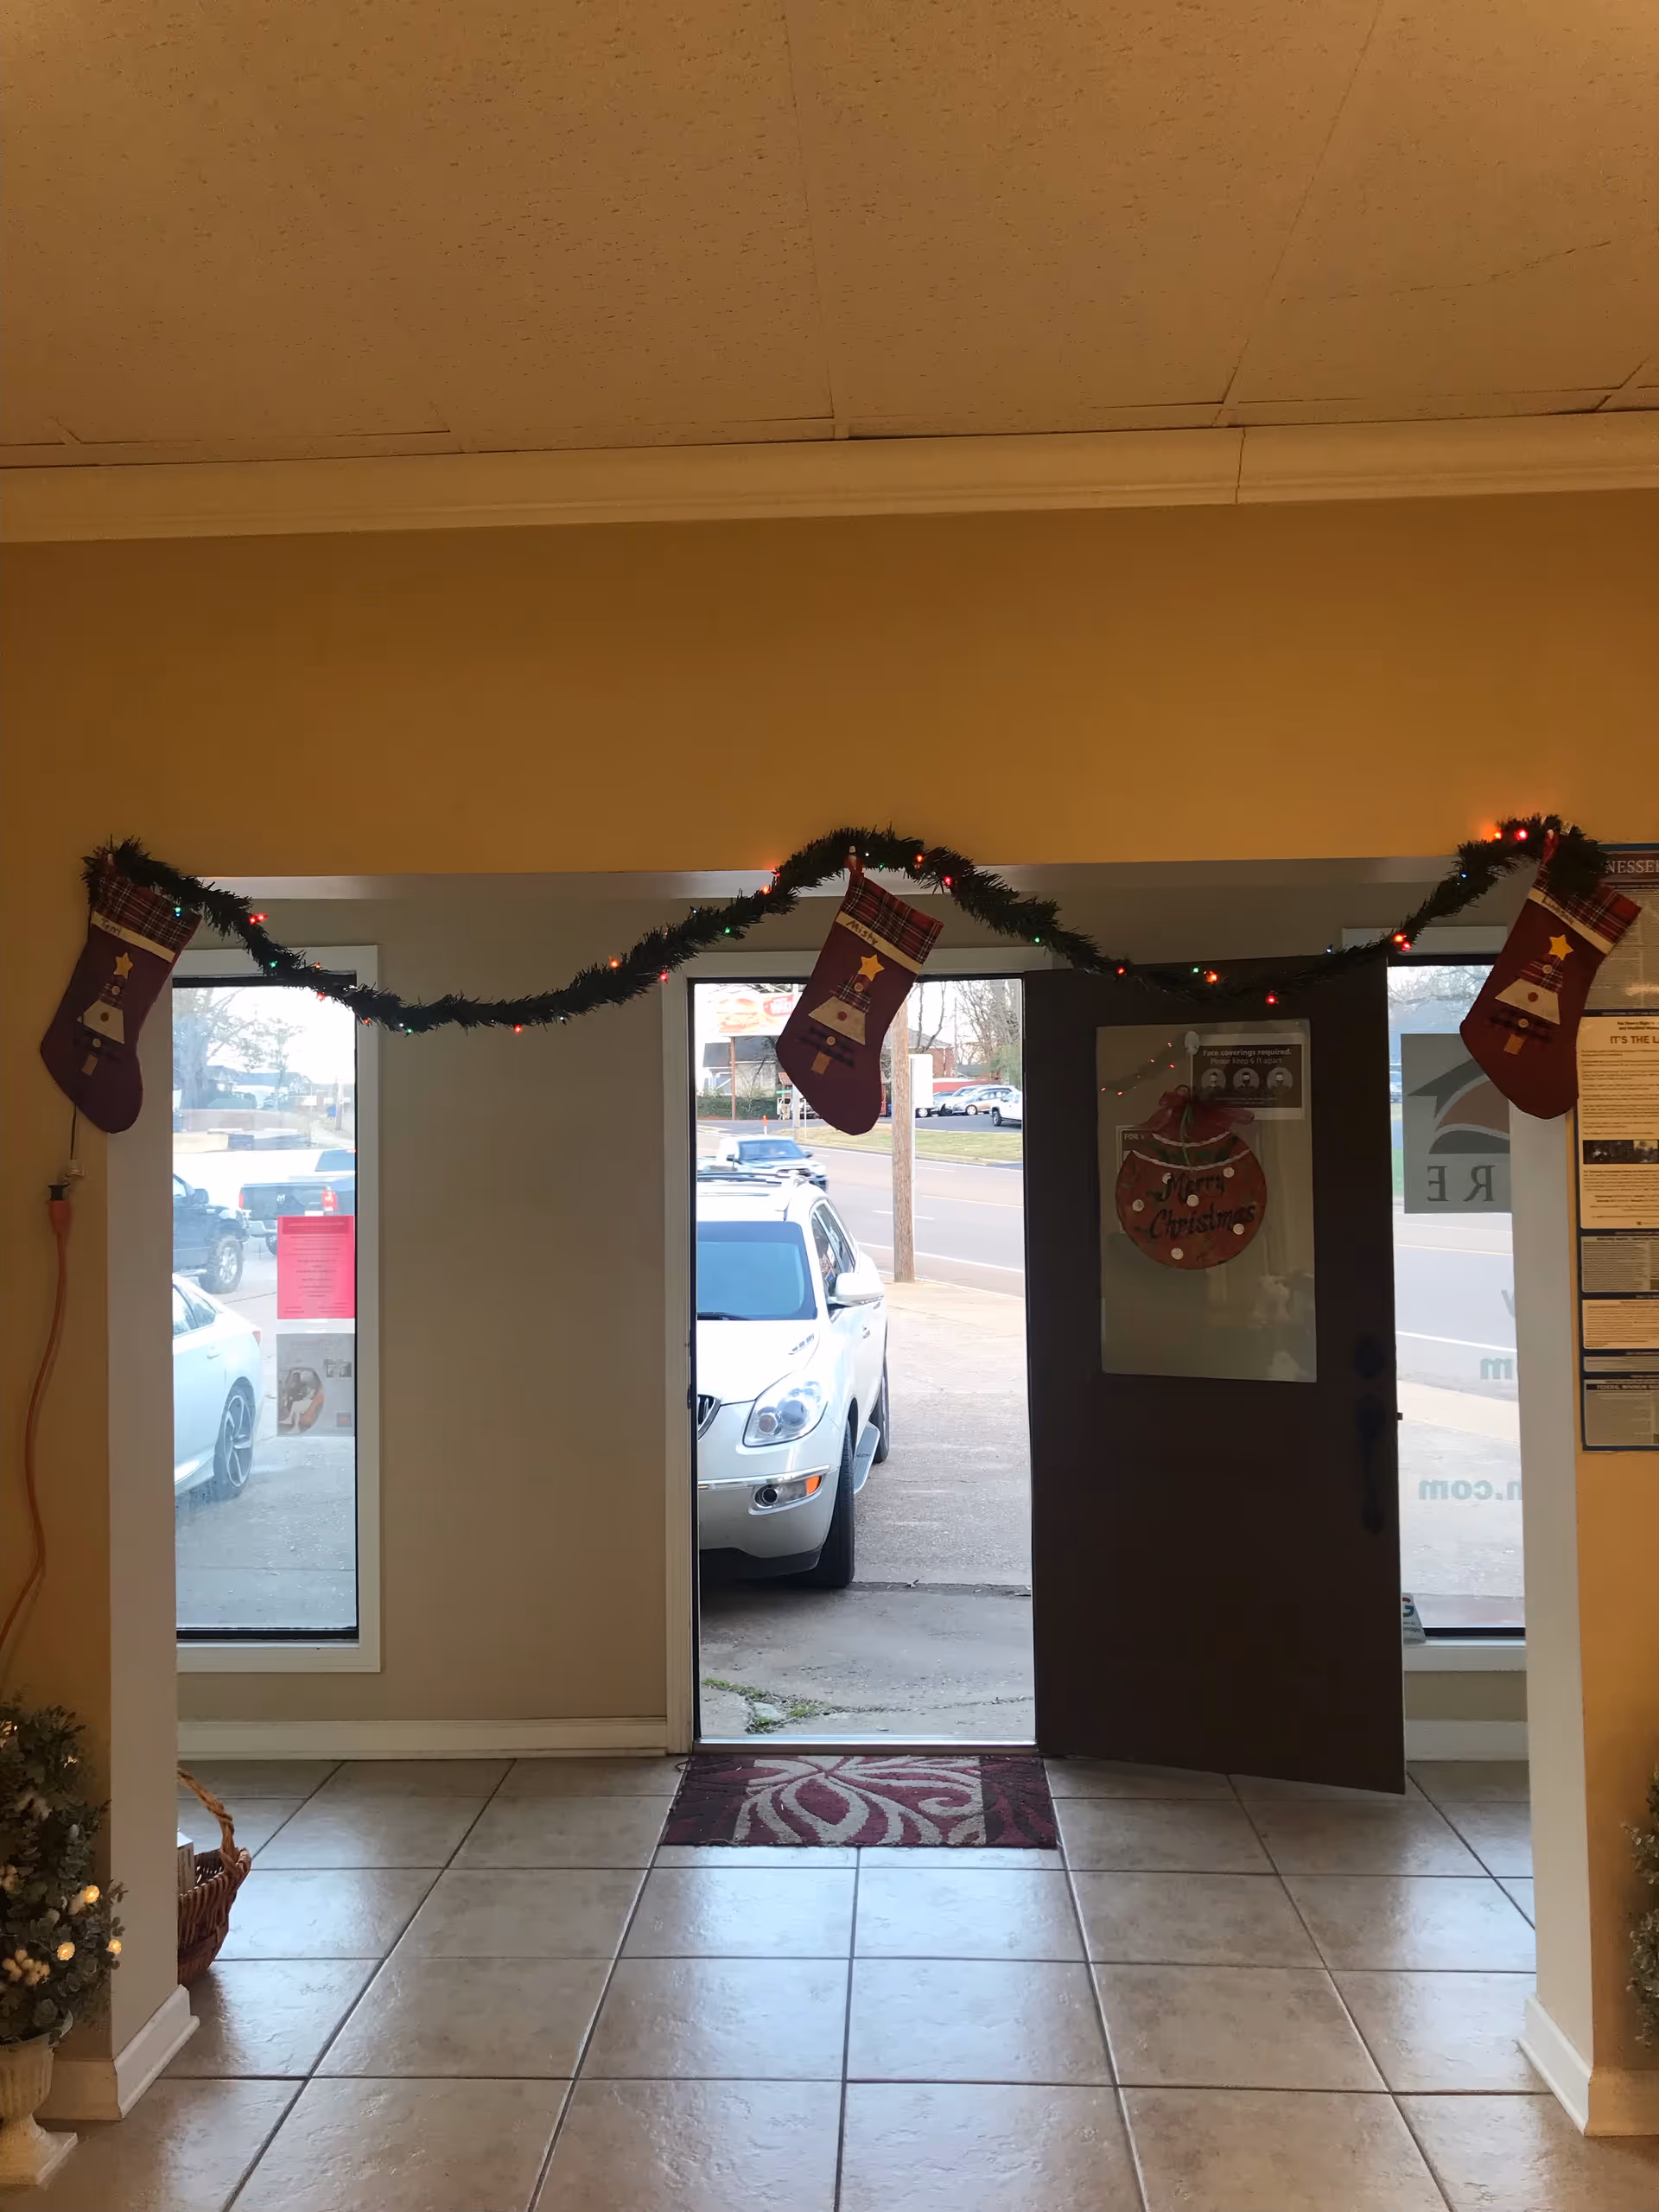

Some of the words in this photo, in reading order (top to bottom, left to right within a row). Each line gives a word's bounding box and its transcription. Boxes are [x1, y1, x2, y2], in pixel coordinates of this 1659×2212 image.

[1630, 1035, 1649, 1044] THE
[1150, 1173, 1224, 1203] Merry
[1149, 1202, 1256, 1239] Christmas
